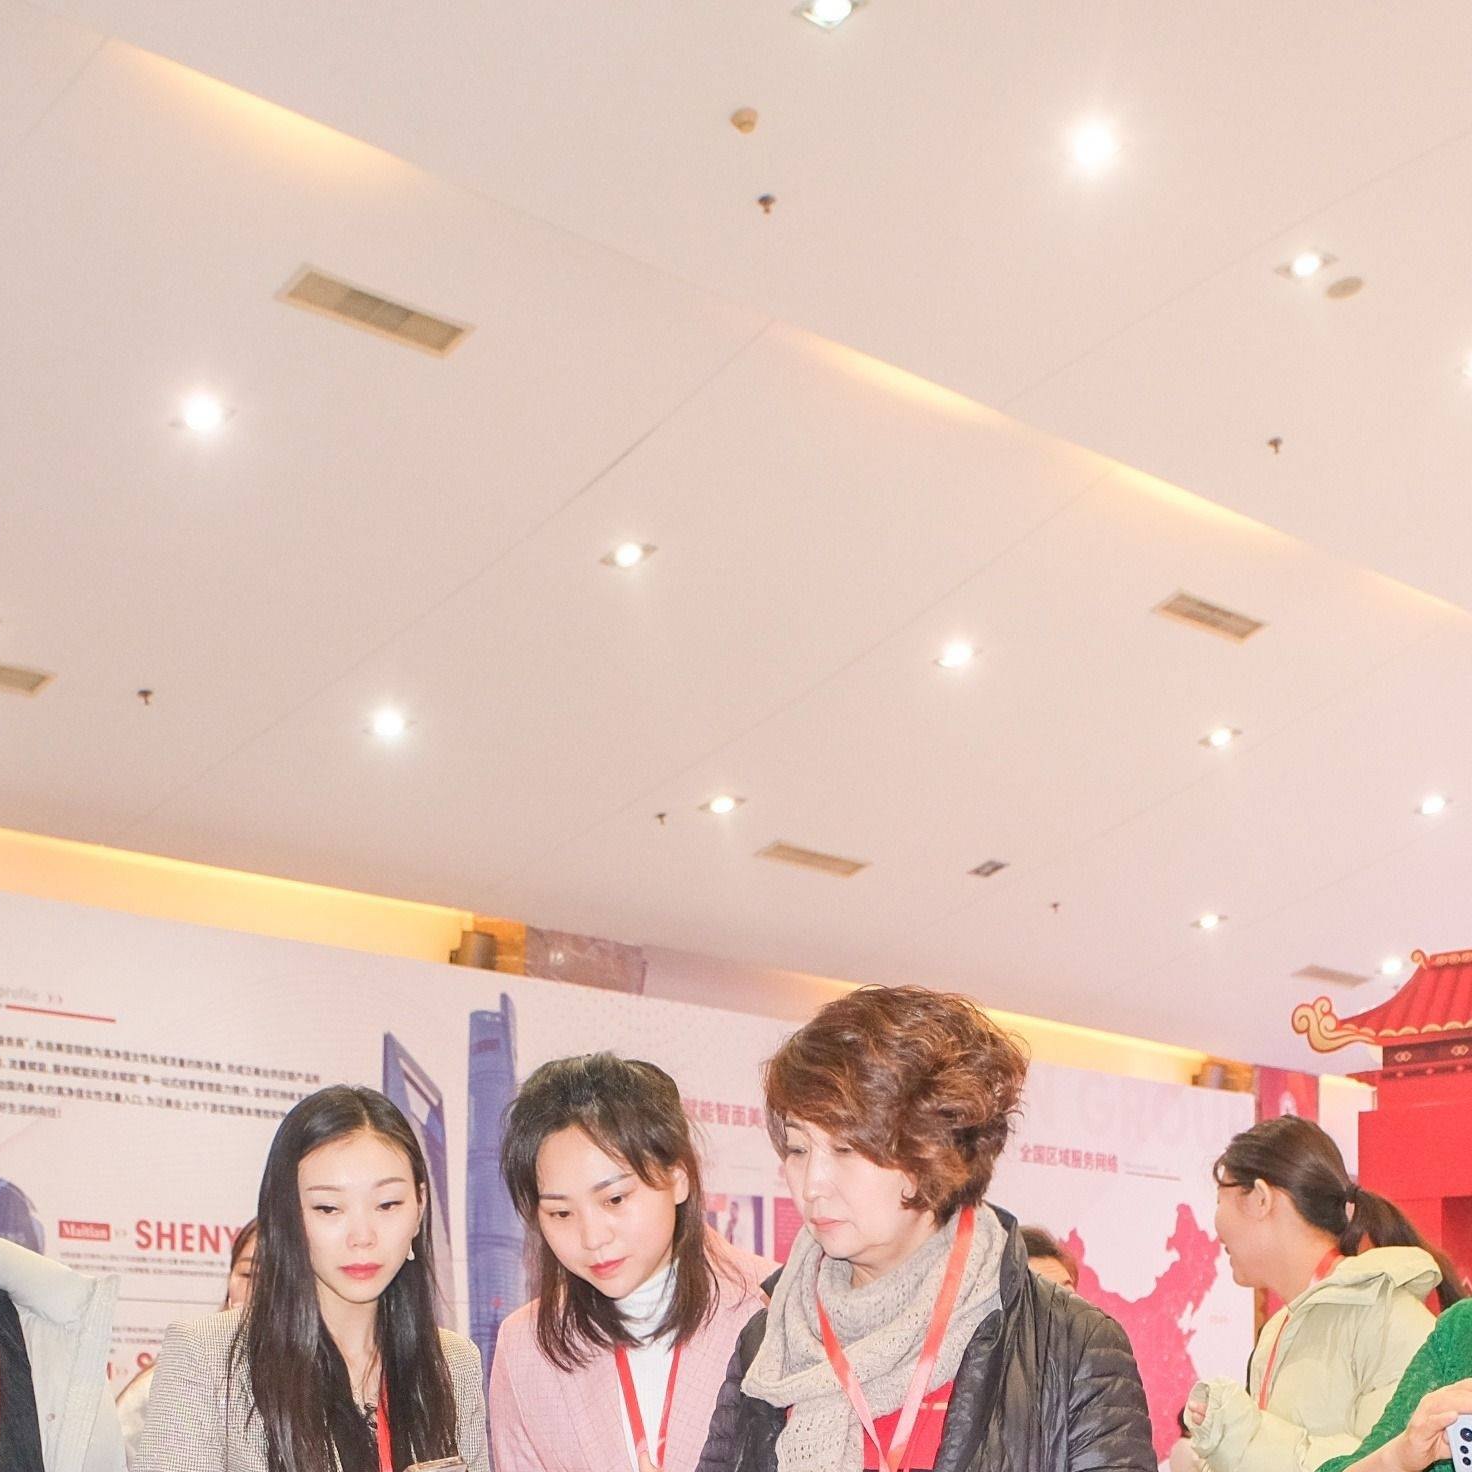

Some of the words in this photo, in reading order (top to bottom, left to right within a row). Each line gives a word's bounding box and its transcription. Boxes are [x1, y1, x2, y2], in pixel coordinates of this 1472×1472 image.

[1020, 1144, 1119, 1174] 全国区域服务网络
[62, 1222, 107, 1239] Maitian
